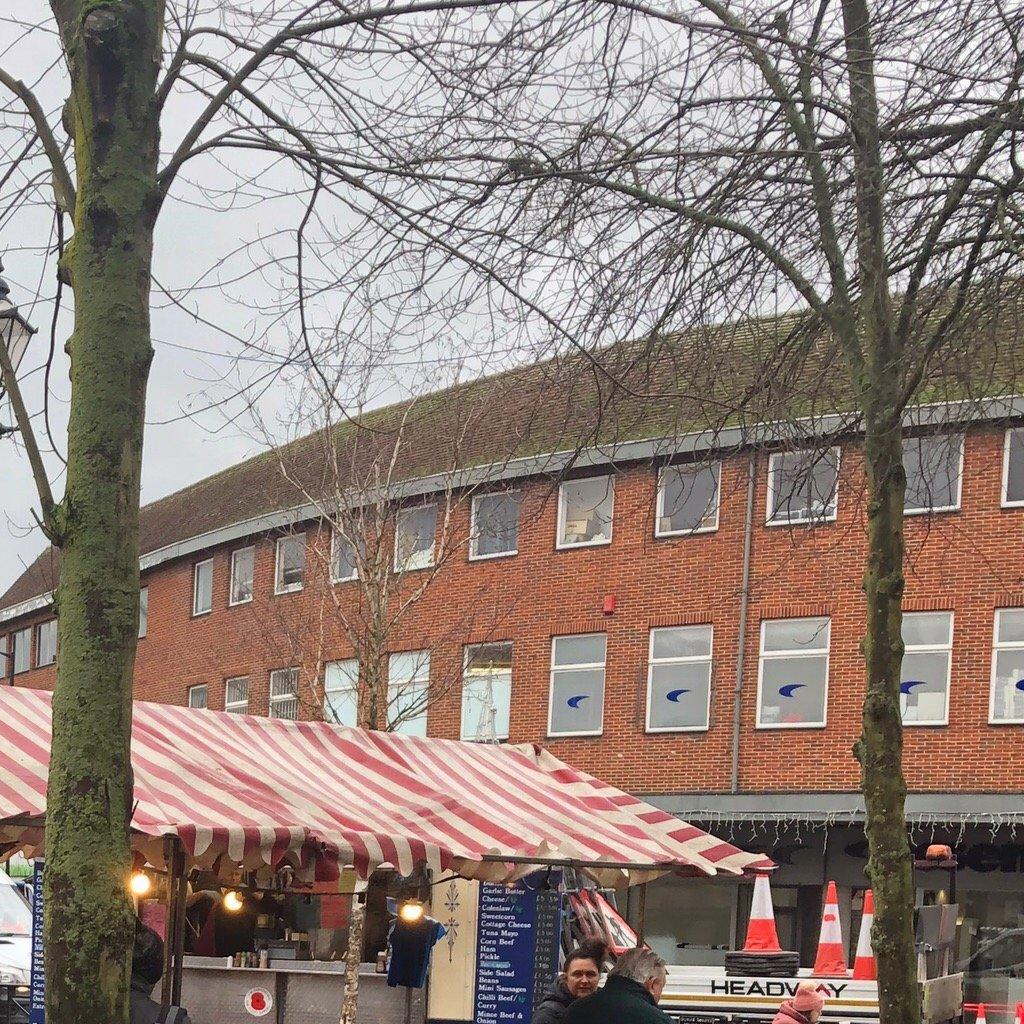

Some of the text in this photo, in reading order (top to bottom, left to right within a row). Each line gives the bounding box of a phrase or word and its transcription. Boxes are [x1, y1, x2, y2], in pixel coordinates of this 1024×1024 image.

[499, 938, 514, 946] Beef
[496, 985, 527, 993] Sausages
[477, 1002, 497, 1010] Curry
[477, 1010, 497, 1018] Mince
[499, 1011, 515, 1019] Beef
[476, 1017, 497, 1024] Onion
